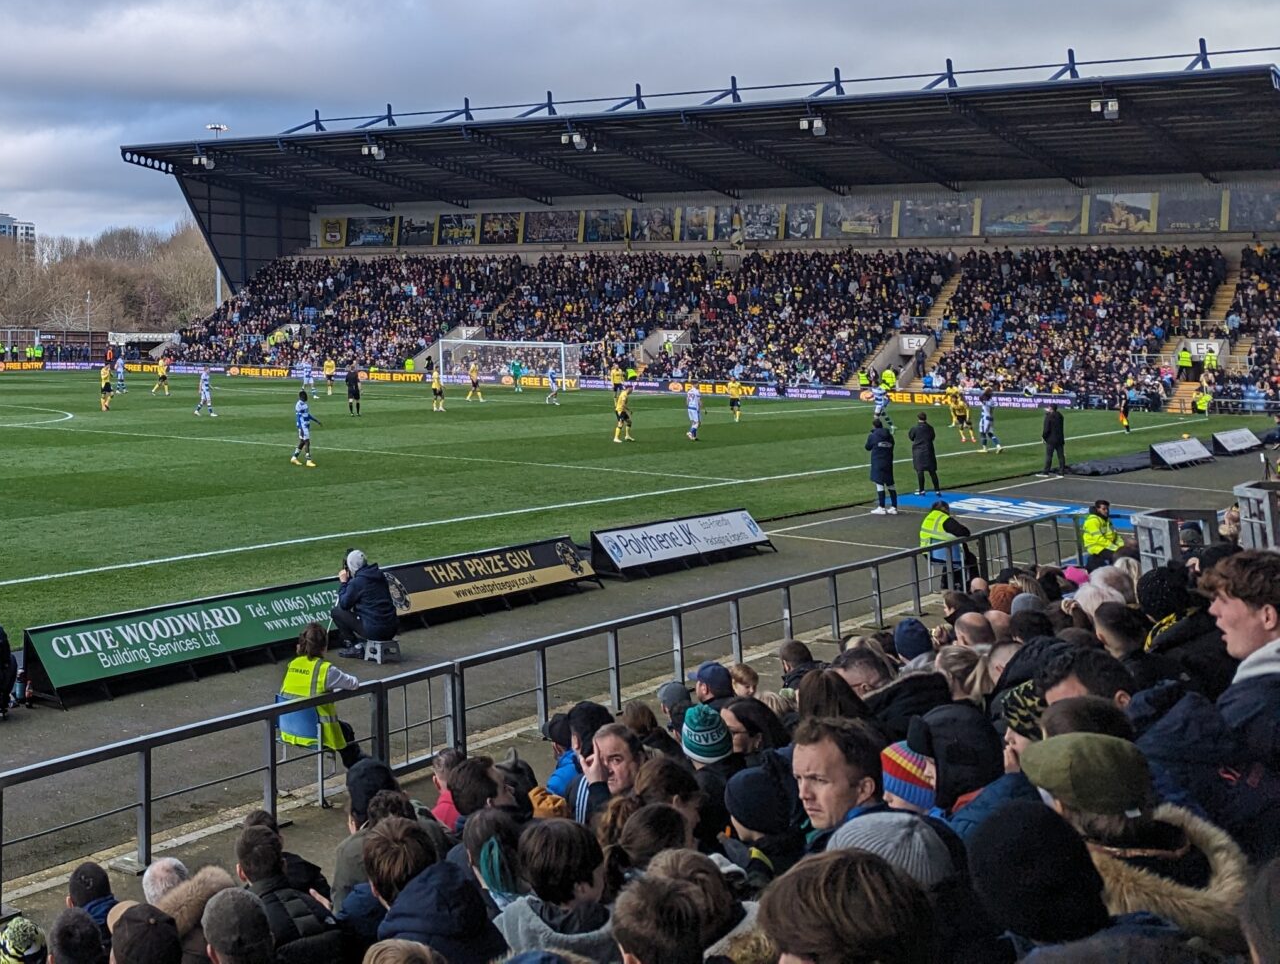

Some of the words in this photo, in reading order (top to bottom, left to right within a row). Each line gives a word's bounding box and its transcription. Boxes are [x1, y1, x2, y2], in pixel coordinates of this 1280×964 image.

[908, 338, 921, 348] E4
[5, 362, 22, 370] FREE
[22, 362, 43, 370] ENTRY
[240, 368, 260, 376] FREE
[262, 368, 289, 377] ENTRY
[370, 373, 394, 381] FREE
[396, 374, 423, 382] ENTRY
[520, 376, 541, 386] REE
[542, 378, 577, 388] ETRY
[684, 383, 713, 394] FEE
[888, 392, 912, 402] REE
[616, 526, 682, 558] Polythene
[678, 523, 702, 546] UK
[424, 562, 466, 584] THAT
[464, 555, 510, 578] PRIZE
[506, 550, 536, 570] GUY
[453, 573, 538, 599] www.thatprizeguy.co.uk
[52, 628, 120, 660] CLIVE
[117, 605, 242, 647] WOODWARD
[245, 604, 270, 618] Tel:
[271, 596, 310, 616] (01865)
[306, 590, 340, 607] 361725
[97, 644, 150, 669] Building
[152, 636, 200, 660] Services
[203, 630, 222, 647] Ltd
